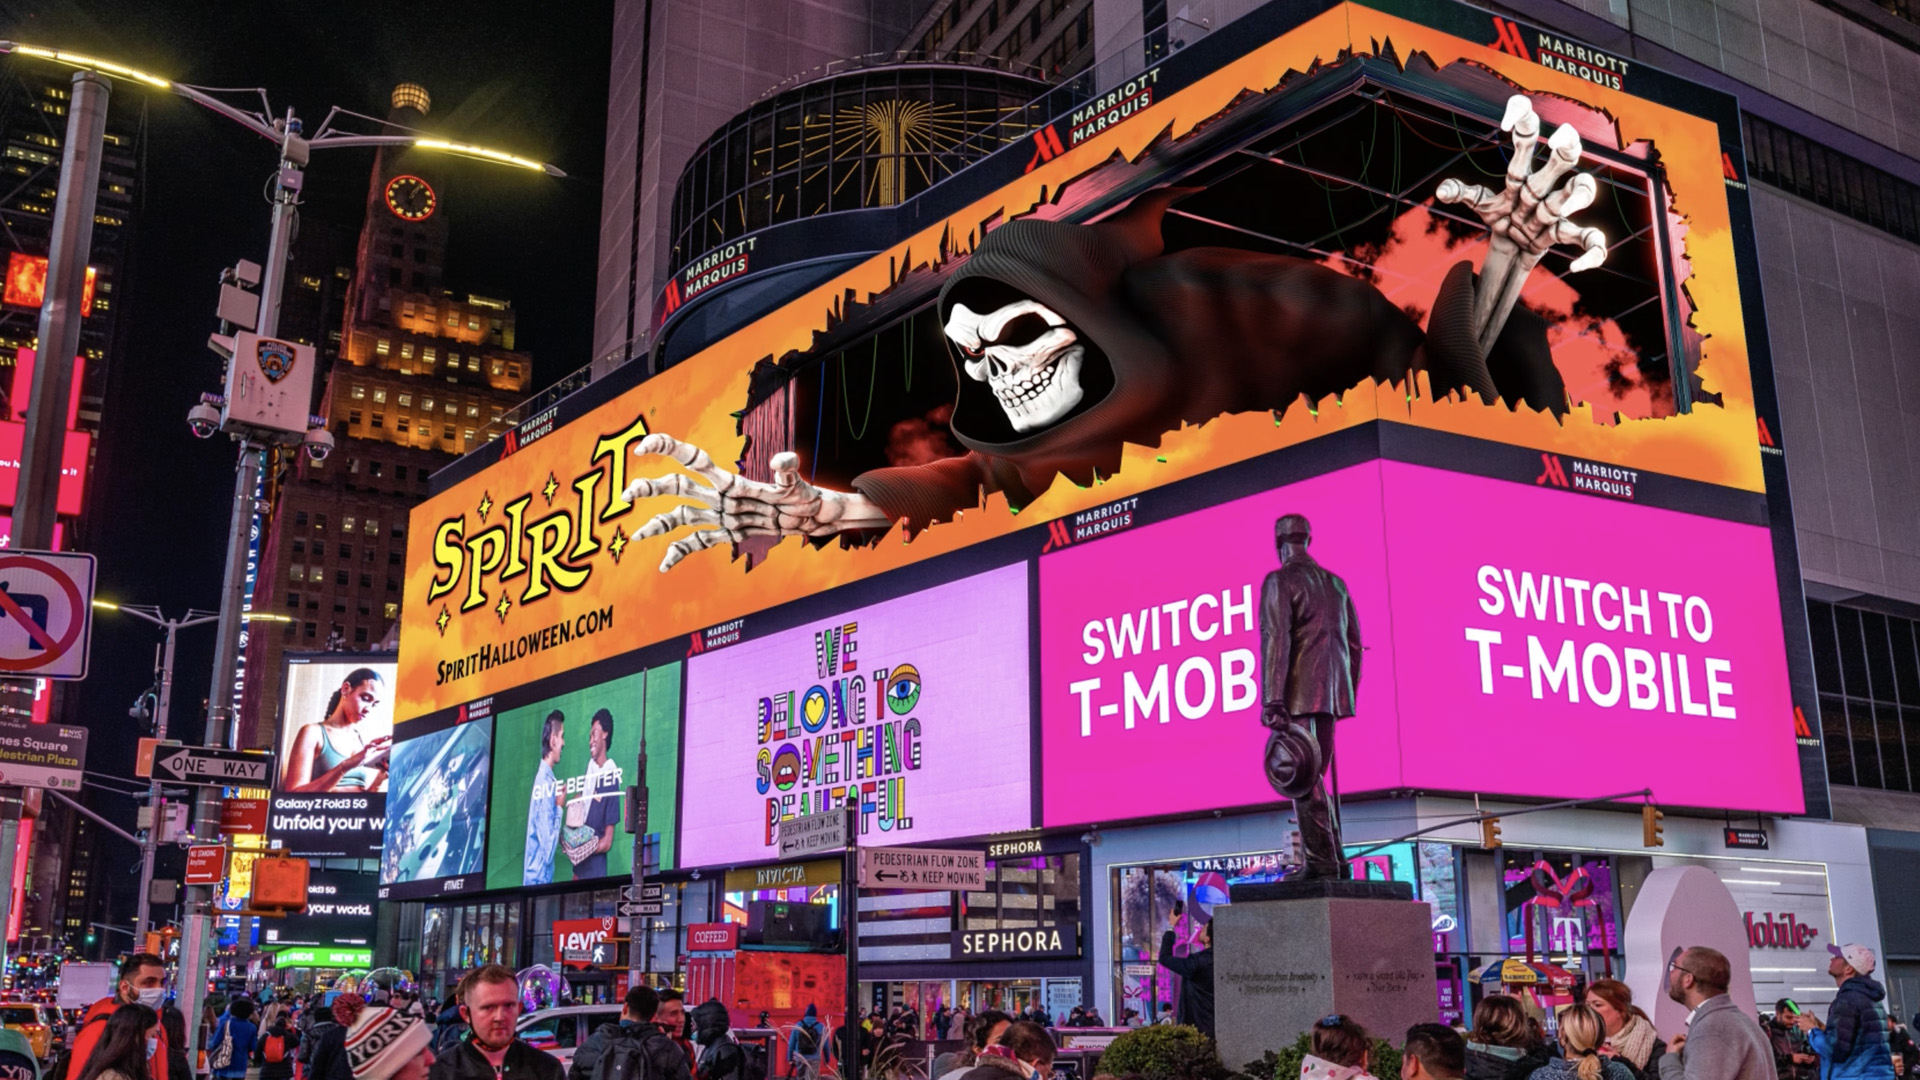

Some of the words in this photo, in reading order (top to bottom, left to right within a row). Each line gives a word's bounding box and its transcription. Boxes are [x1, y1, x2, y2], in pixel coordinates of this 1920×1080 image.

[1538, 33, 1629, 76] MARRIOTT
[1540, 53, 1622, 91] MARQUIS
[1071, 67, 1161, 127] MARRIOTT
[1072, 92, 1153, 144] MARQUIS
[685, 237, 758, 280] MARRIOTT
[686, 259, 747, 298] MARQUIS
[520, 407, 559, 433] MARRIOTT
[519, 422, 554, 448] MARQUIS
[1573, 461, 1638, 484] MARRIOTT
[1574, 475, 1633, 498] MARQUIS
[427, 414, 651, 614] SPIRIT
[1076, 497, 1139, 526] MARRIOTT
[1076, 513, 1131, 540] MARQUIS
[1477, 565, 1652, 635] SWITCH
[1658, 591, 1714, 643] TO
[707, 620, 745, 638] MARRIOTT
[1082, 584, 1254, 665] SWITCH
[706, 632, 740, 650] MARQUIS
[815, 622, 858, 679] WE
[1465, 627, 1737, 720] T-MOBILE
[469, 697, 494, 712] MARRIOTT
[758, 674, 866, 745] BELONG
[873, 663, 922, 720] TO
[1069, 648, 1258, 737] T-MOB
[468, 707, 491, 720] MARQUIS
[23, 736, 68, 752] Square
[756, 717, 922, 795] SOMETHING
[46, 753, 78, 767] Plaza
[172, 754, 207, 774] ONE
[223, 762, 260, 778] WAY
[532, 780, 565, 801] GIVE
[566, 767, 624, 795] BETTER
[230, 802, 257, 810] STANDING
[275, 798, 314, 811] Galaxy
[314, 799, 322, 809] Z
[323, 798, 351, 810] Fold3
[352, 799, 368, 810] 5G
[272, 814, 326, 831] Unfold
[328, 818, 366, 835] your
[780, 820, 810, 837] PEDESTRIAN
[811, 816, 826, 831] FLOW
[826, 813, 840, 829] ZONE
[806, 835, 819, 847] KEEP
[820, 829, 840, 845] MOVING
[990, 840, 1042, 857] SEPHORA
[190, 850, 198, 858] NO
[198, 849, 217, 858] STANDING
[190, 859, 207, 867] Anytime
[874, 852, 928, 868] PEDESTRIAN
[930, 854, 954, 868] FLOW
[957, 856, 980, 869] ZONE
[756, 864, 806, 885] INVICTA
[922, 869, 945, 884] KEEP
[947, 870, 980, 885] MOVING
[308, 885, 325, 894] old3
[325, 886, 336, 895] 5G
[308, 903, 335, 916] your
[336, 904, 372, 916] world.
[694, 930, 729, 944] COFFEED
[962, 930, 1062, 954] SEPHORA
[350, 1012, 415, 1063] YORK
[1, 1064, 35, 1080] YOR
